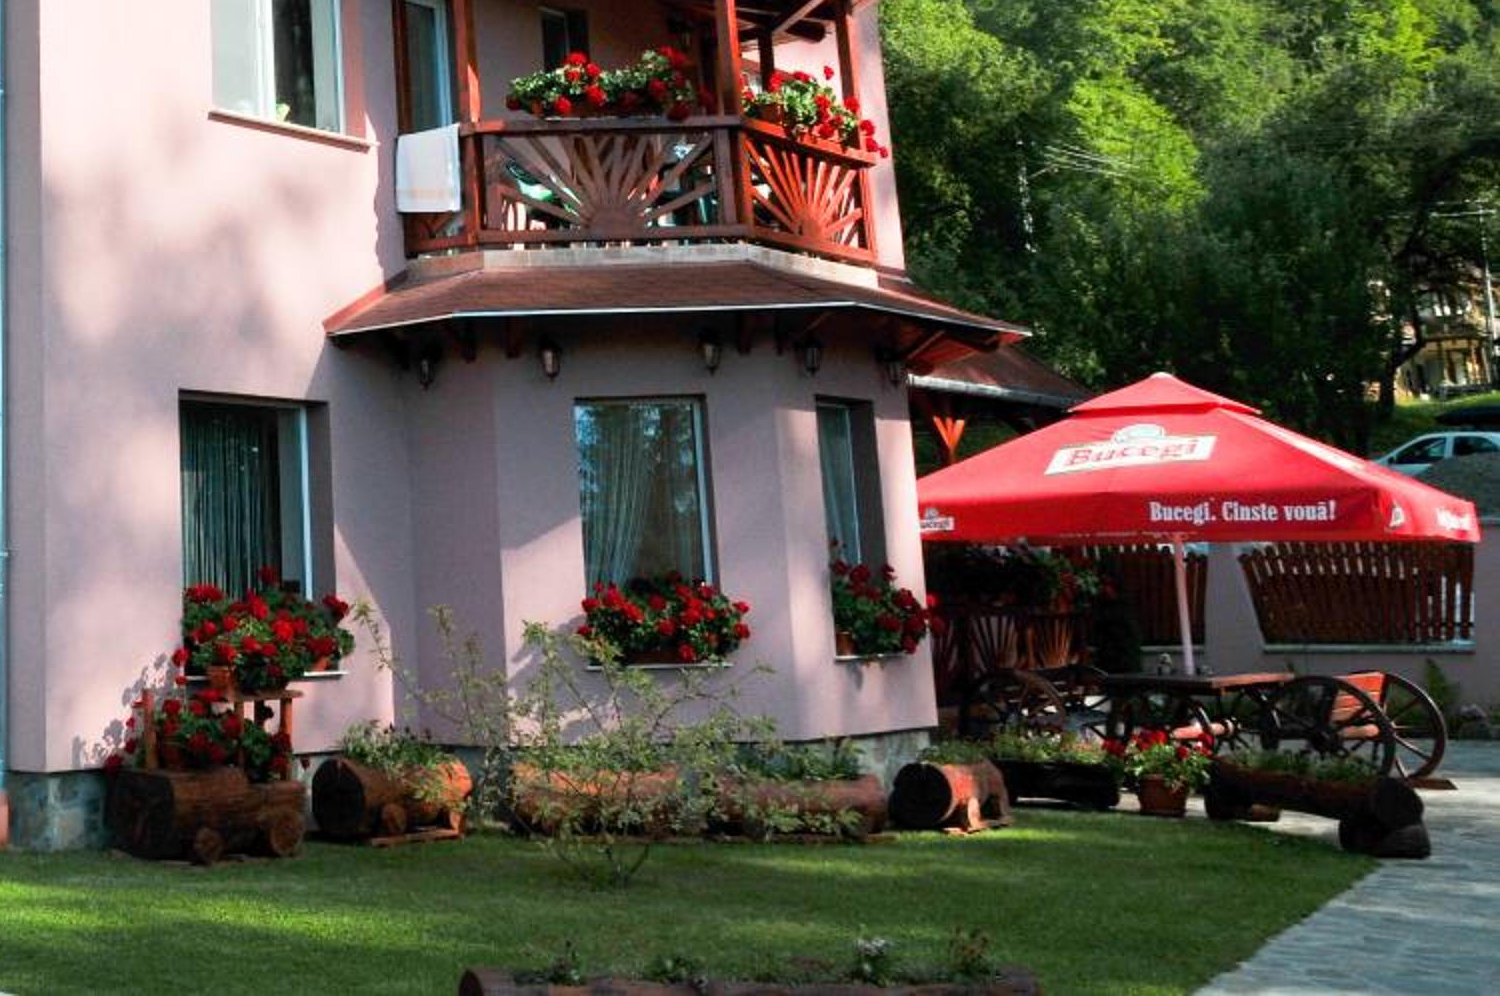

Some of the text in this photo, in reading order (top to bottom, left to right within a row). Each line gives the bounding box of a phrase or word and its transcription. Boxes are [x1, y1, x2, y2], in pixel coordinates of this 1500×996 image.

[1064, 440, 1199, 466] Bucegi
[1149, 501, 1217, 525] Bucegi.
[1221, 500, 1278, 521] Cinste
